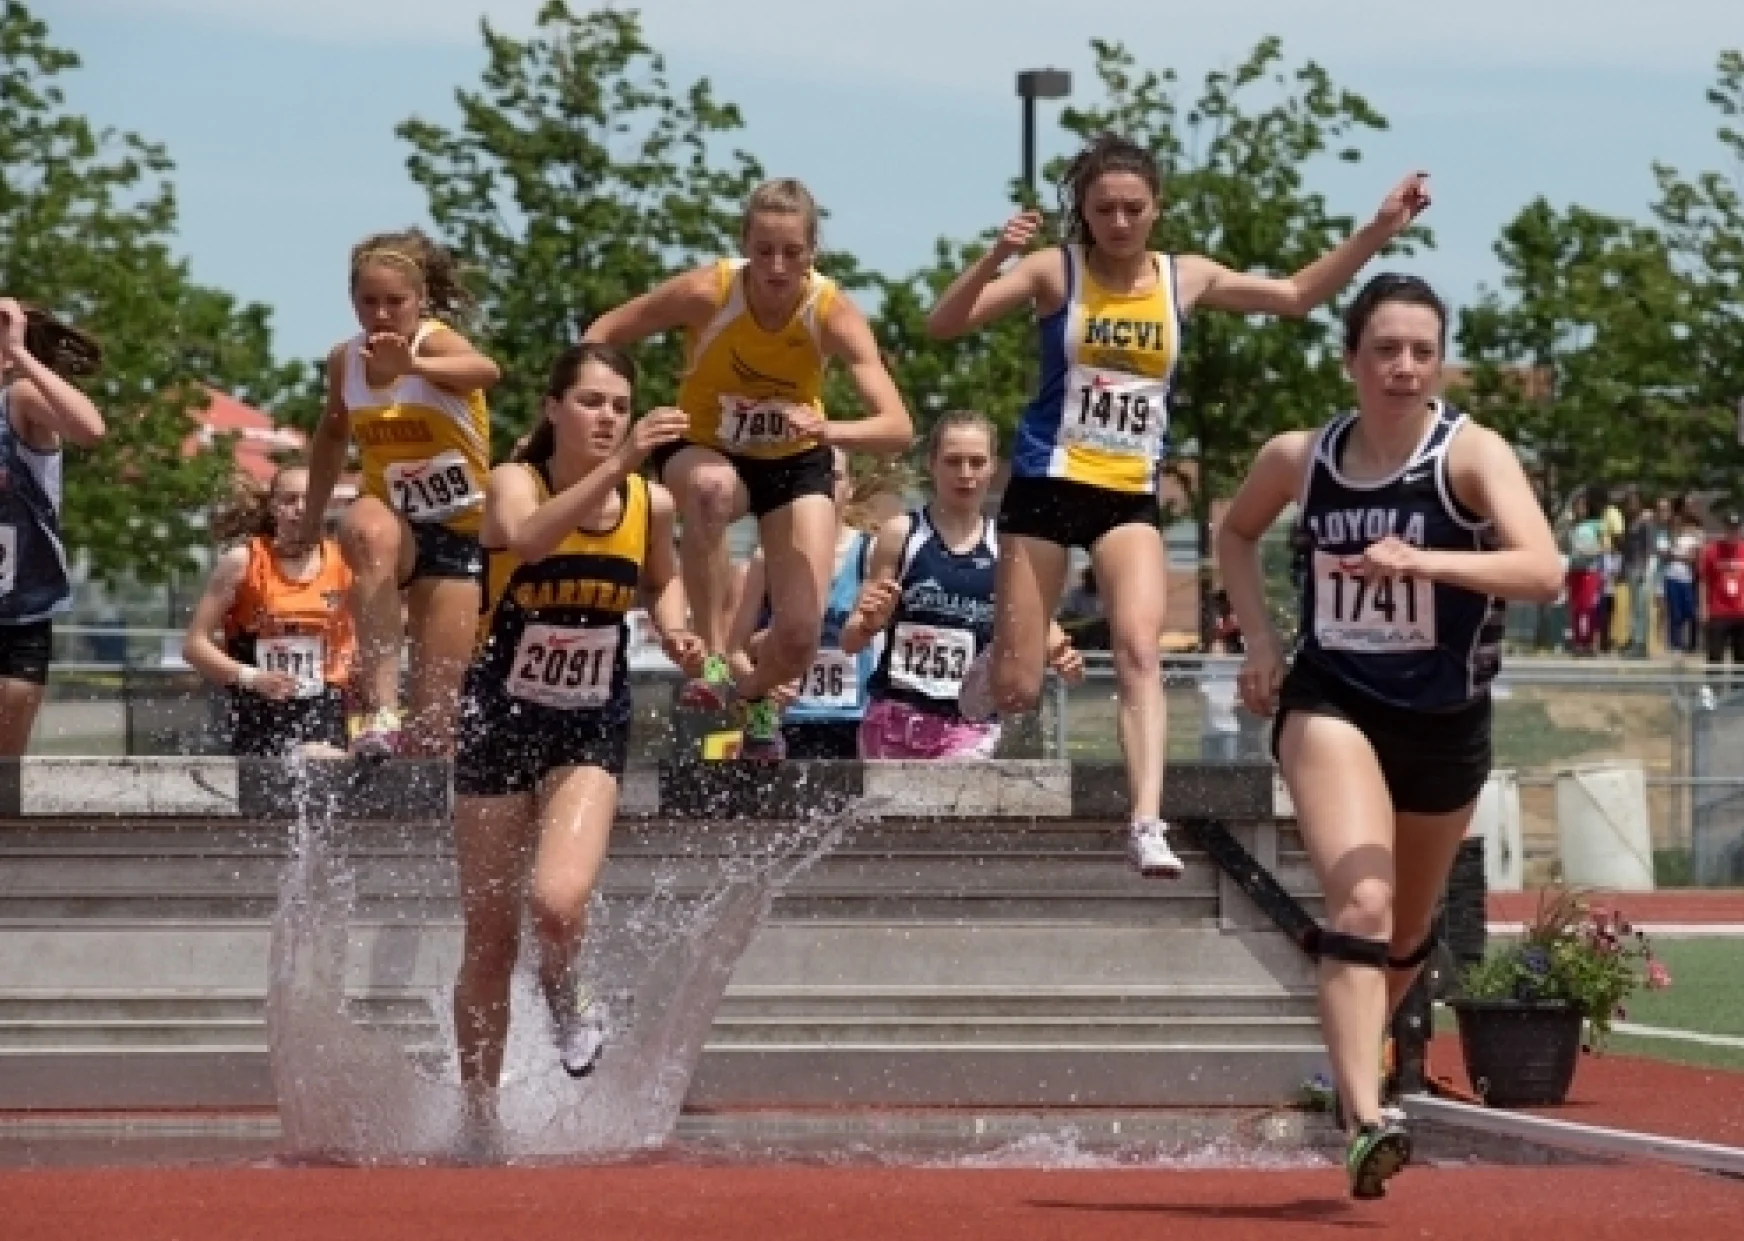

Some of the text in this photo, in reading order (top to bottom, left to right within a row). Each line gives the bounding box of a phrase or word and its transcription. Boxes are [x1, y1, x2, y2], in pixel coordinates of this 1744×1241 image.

[1085, 317, 1164, 351] MCVI
[1078, 385, 1150, 435] 1419
[393, 466, 469, 513] 2199
[1308, 508, 1425, 546] LOYOLA
[1328, 571, 1419, 623] 1741
[519, 643, 607, 690] 2091
[904, 640, 967, 679] 1253
